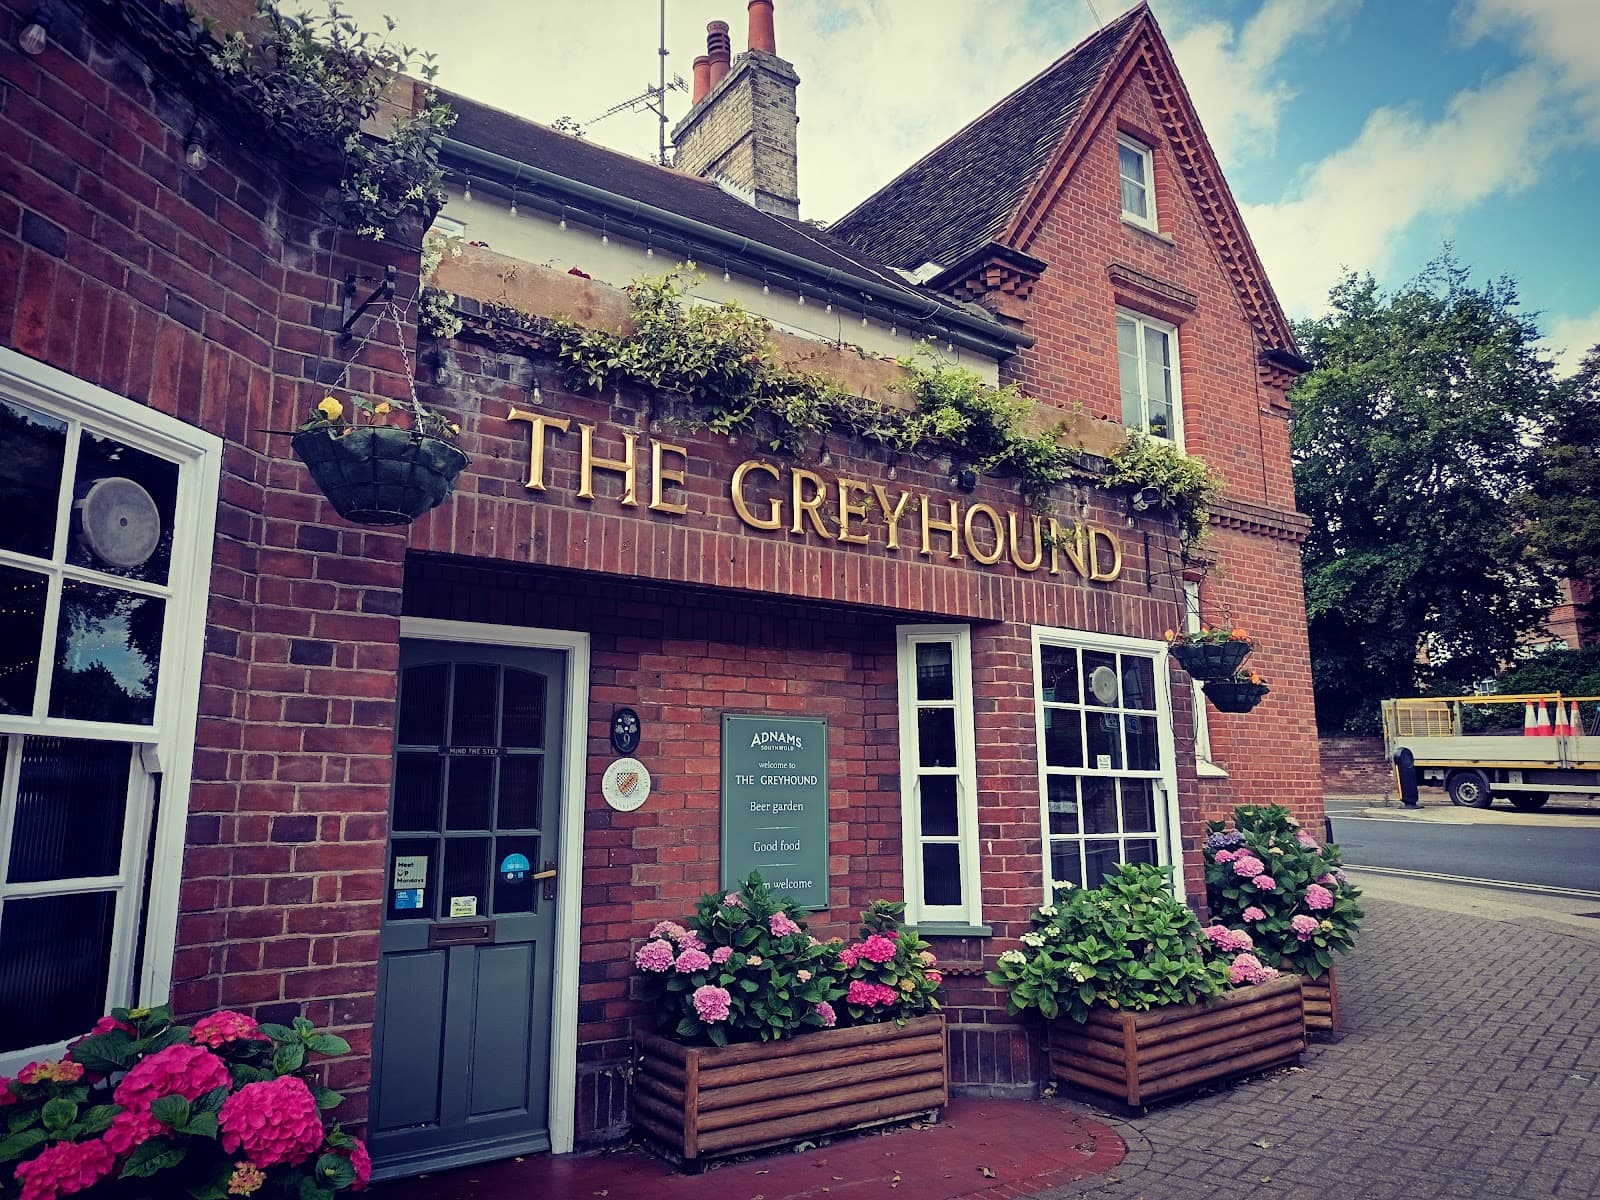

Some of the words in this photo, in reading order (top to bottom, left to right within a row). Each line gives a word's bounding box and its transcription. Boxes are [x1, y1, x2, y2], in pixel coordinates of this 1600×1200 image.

[507, 407, 689, 515] THE
[731, 459, 1122, 583] GREYHOUND
[750, 731, 802, 749] ADNAMS
[758, 761, 788, 769] welcome
[735, 775, 755, 785] THE
[760, 775, 818, 786] GREYHOUND
[750, 801, 771, 812] Beer
[772, 801, 804, 814] garden
[753, 840, 778, 852] Good
[780, 840, 801, 851] food
[773, 878, 813, 889] welcome
